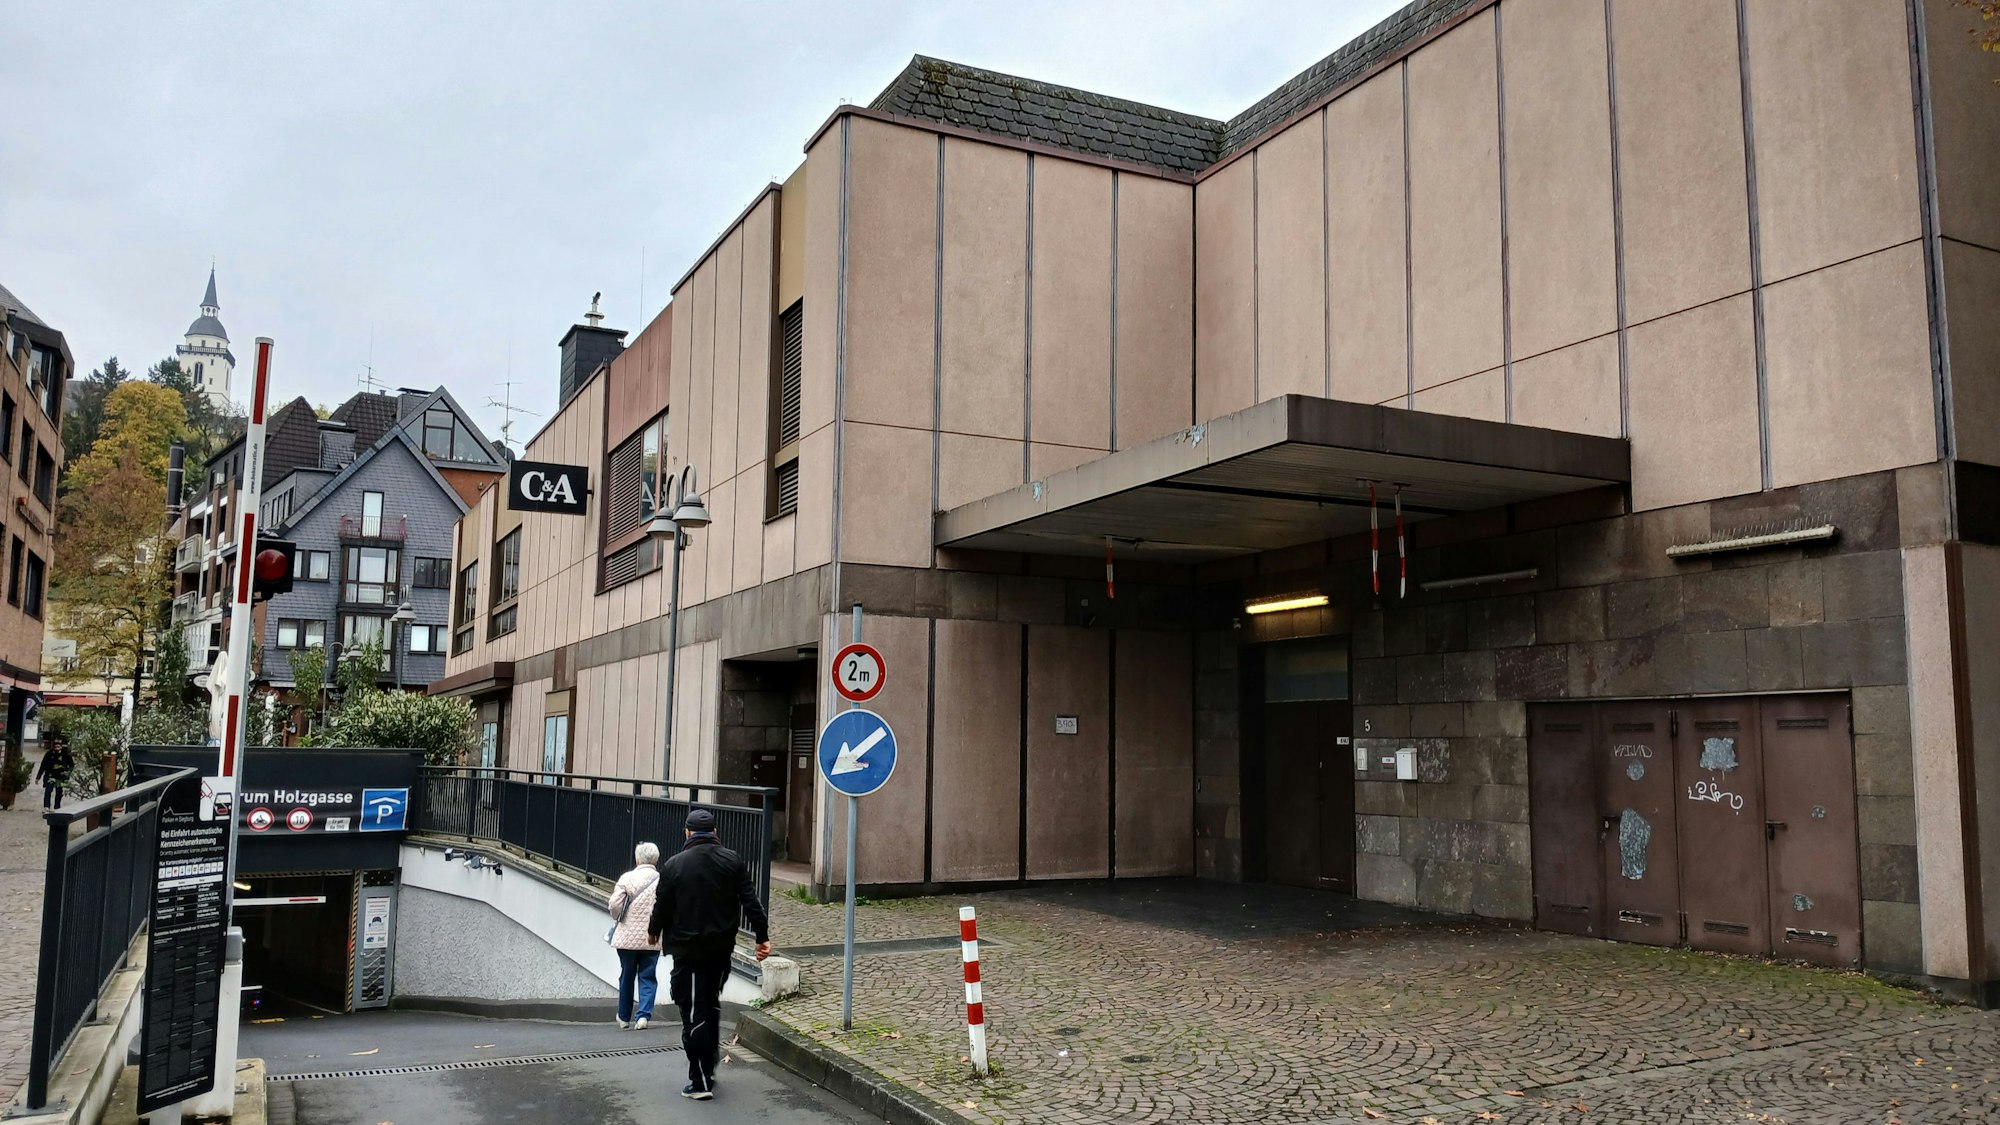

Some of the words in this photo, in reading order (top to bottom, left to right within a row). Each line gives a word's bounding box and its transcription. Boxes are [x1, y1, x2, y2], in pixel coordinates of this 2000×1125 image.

[520, 470, 578, 504] C&A
[848, 661, 857, 681] 2
[859, 671, 870, 682] m
[1364, 719, 1371, 732] 5
[274, 789, 353, 807] Holzgasse
[296, 816, 305, 825] 10
[376, 804, 394, 824] P
[161, 830, 169, 838] Bei
[170, 828, 190, 838] Einfahrt
[191, 826, 223, 836] automatische
[160, 838, 216, 849] Kennzeichenerkennung
